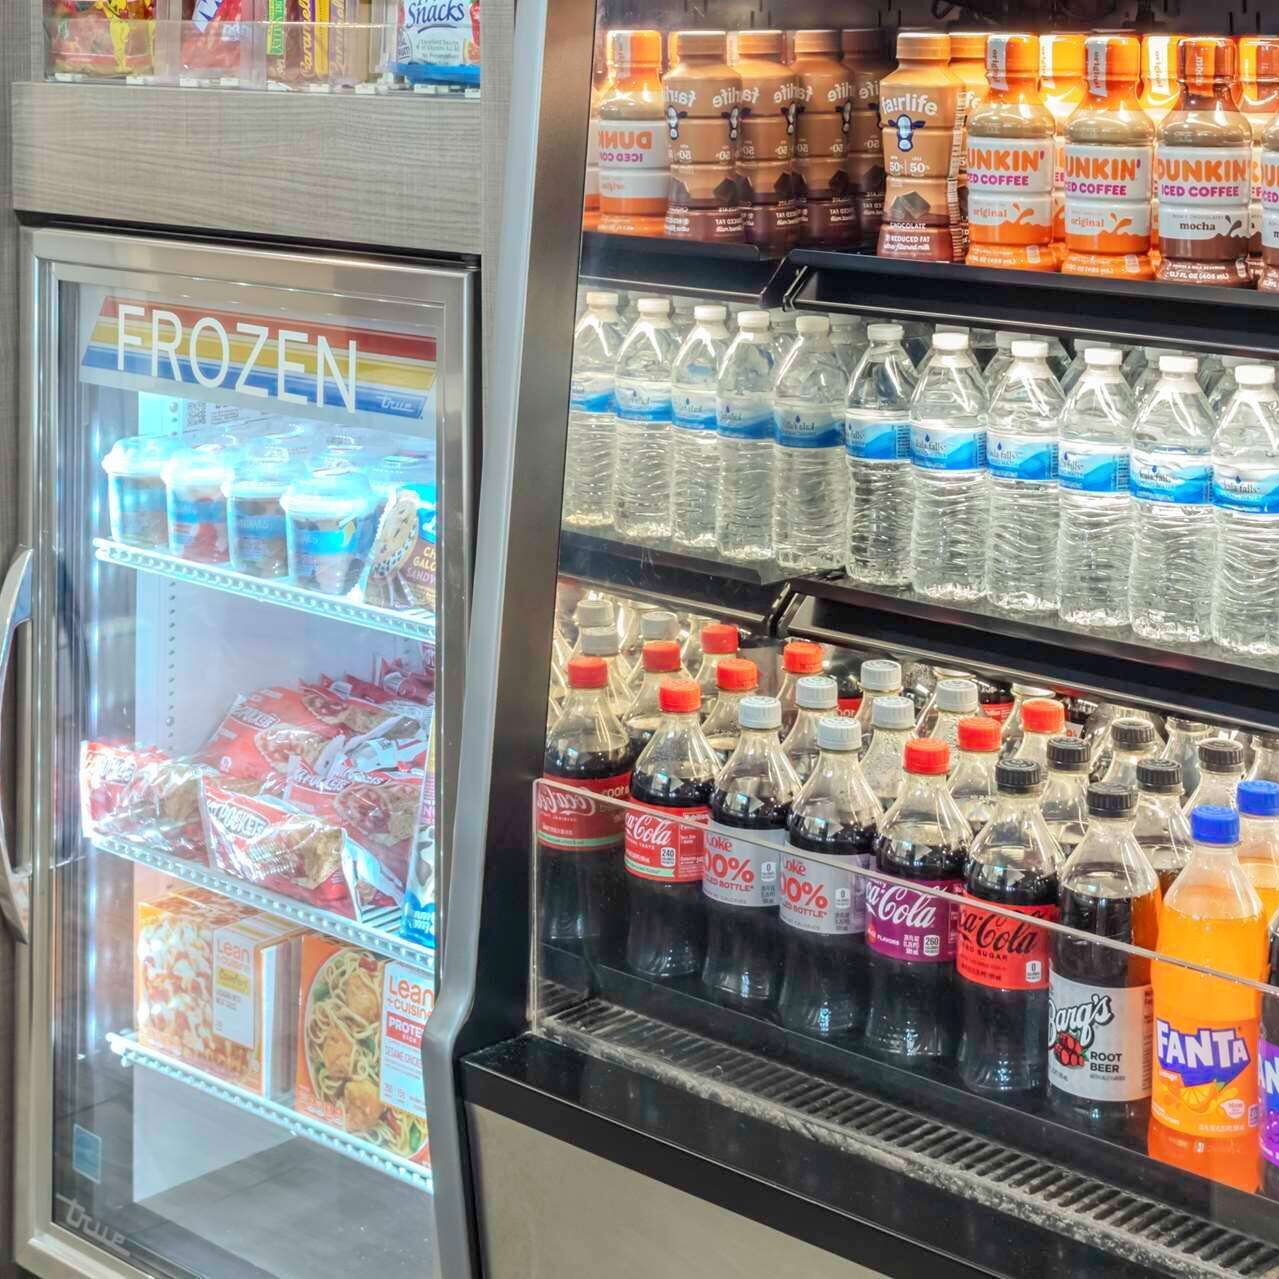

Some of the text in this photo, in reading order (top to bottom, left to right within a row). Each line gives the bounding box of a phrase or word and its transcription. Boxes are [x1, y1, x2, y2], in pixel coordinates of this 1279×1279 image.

[987, 175, 1029, 187] COFFEE
[1083, 183, 1127, 196] COFFEE
[1161, 185, 1240, 198] ICED COFFEE
[1179, 221, 1217, 232] mocha
[116, 303, 357, 414] FROZEN
[661, 848, 675, 858] 240
[877, 933, 900, 947] FLAVORS
[924, 936, 939, 946] 260
[977, 949, 1009, 962] SUGAR
[388, 974, 435, 1008] Lean
[1049, 993, 1115, 1049] Barq's
[1156, 1019, 1249, 1069] FANTA
[1090, 1051, 1123, 1063] ROOT
[1089, 1062, 1120, 1074] BEER
